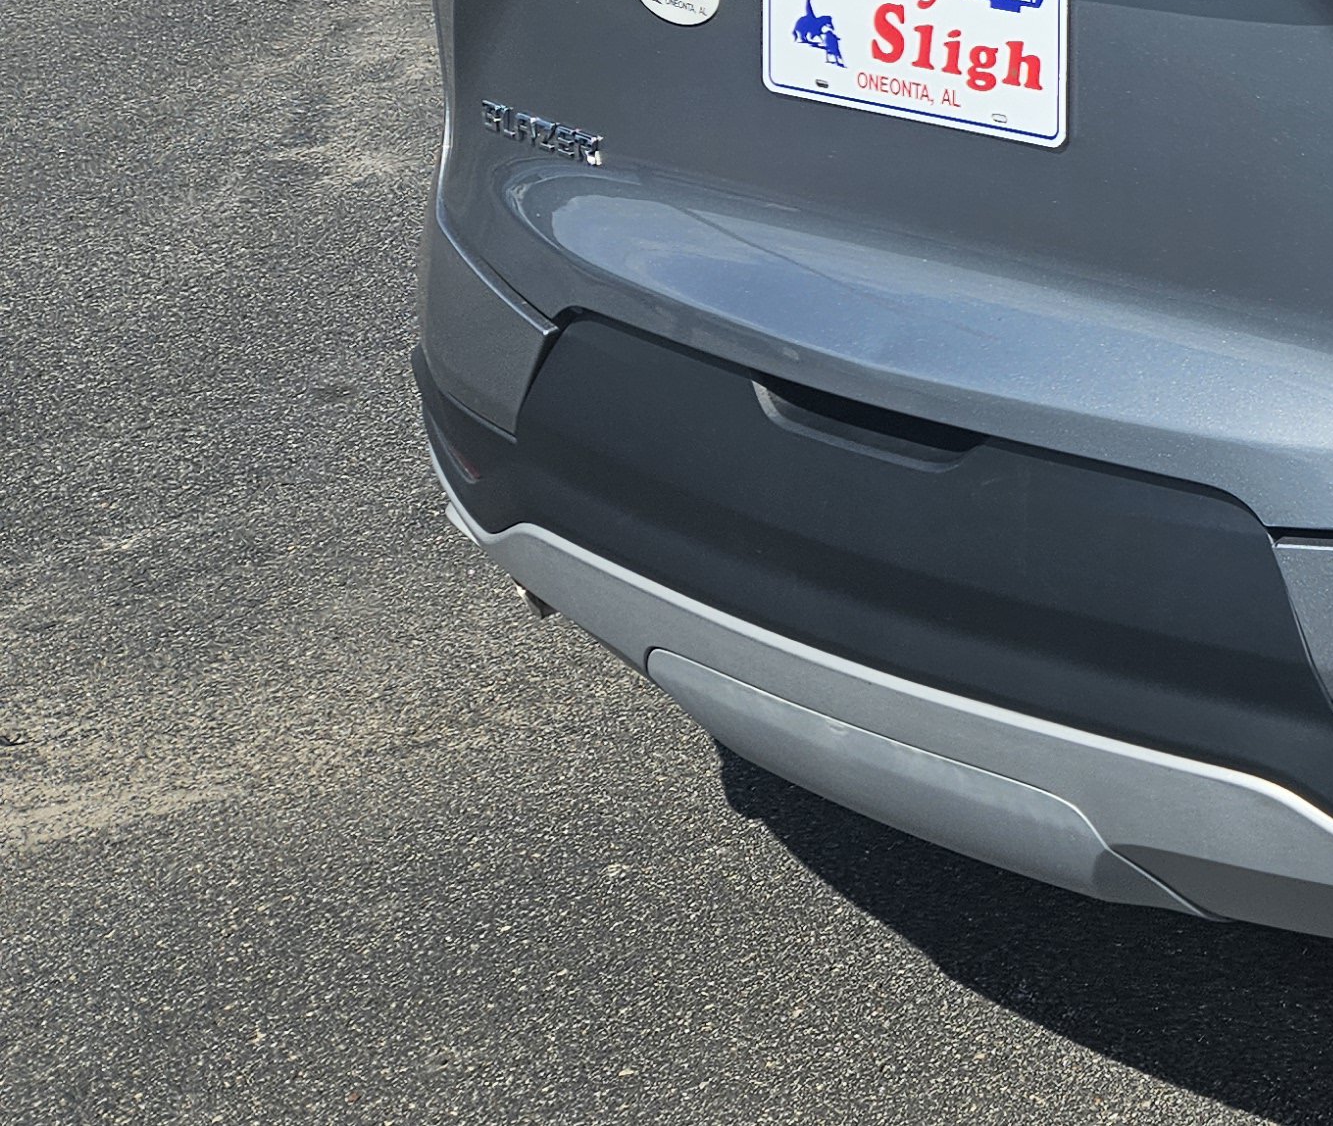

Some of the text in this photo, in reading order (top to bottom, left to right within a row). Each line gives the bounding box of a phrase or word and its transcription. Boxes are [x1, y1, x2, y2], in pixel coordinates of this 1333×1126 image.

[871, 3, 1044, 91] Sligh
[856, 72, 962, 108] ONEONTA, AL
